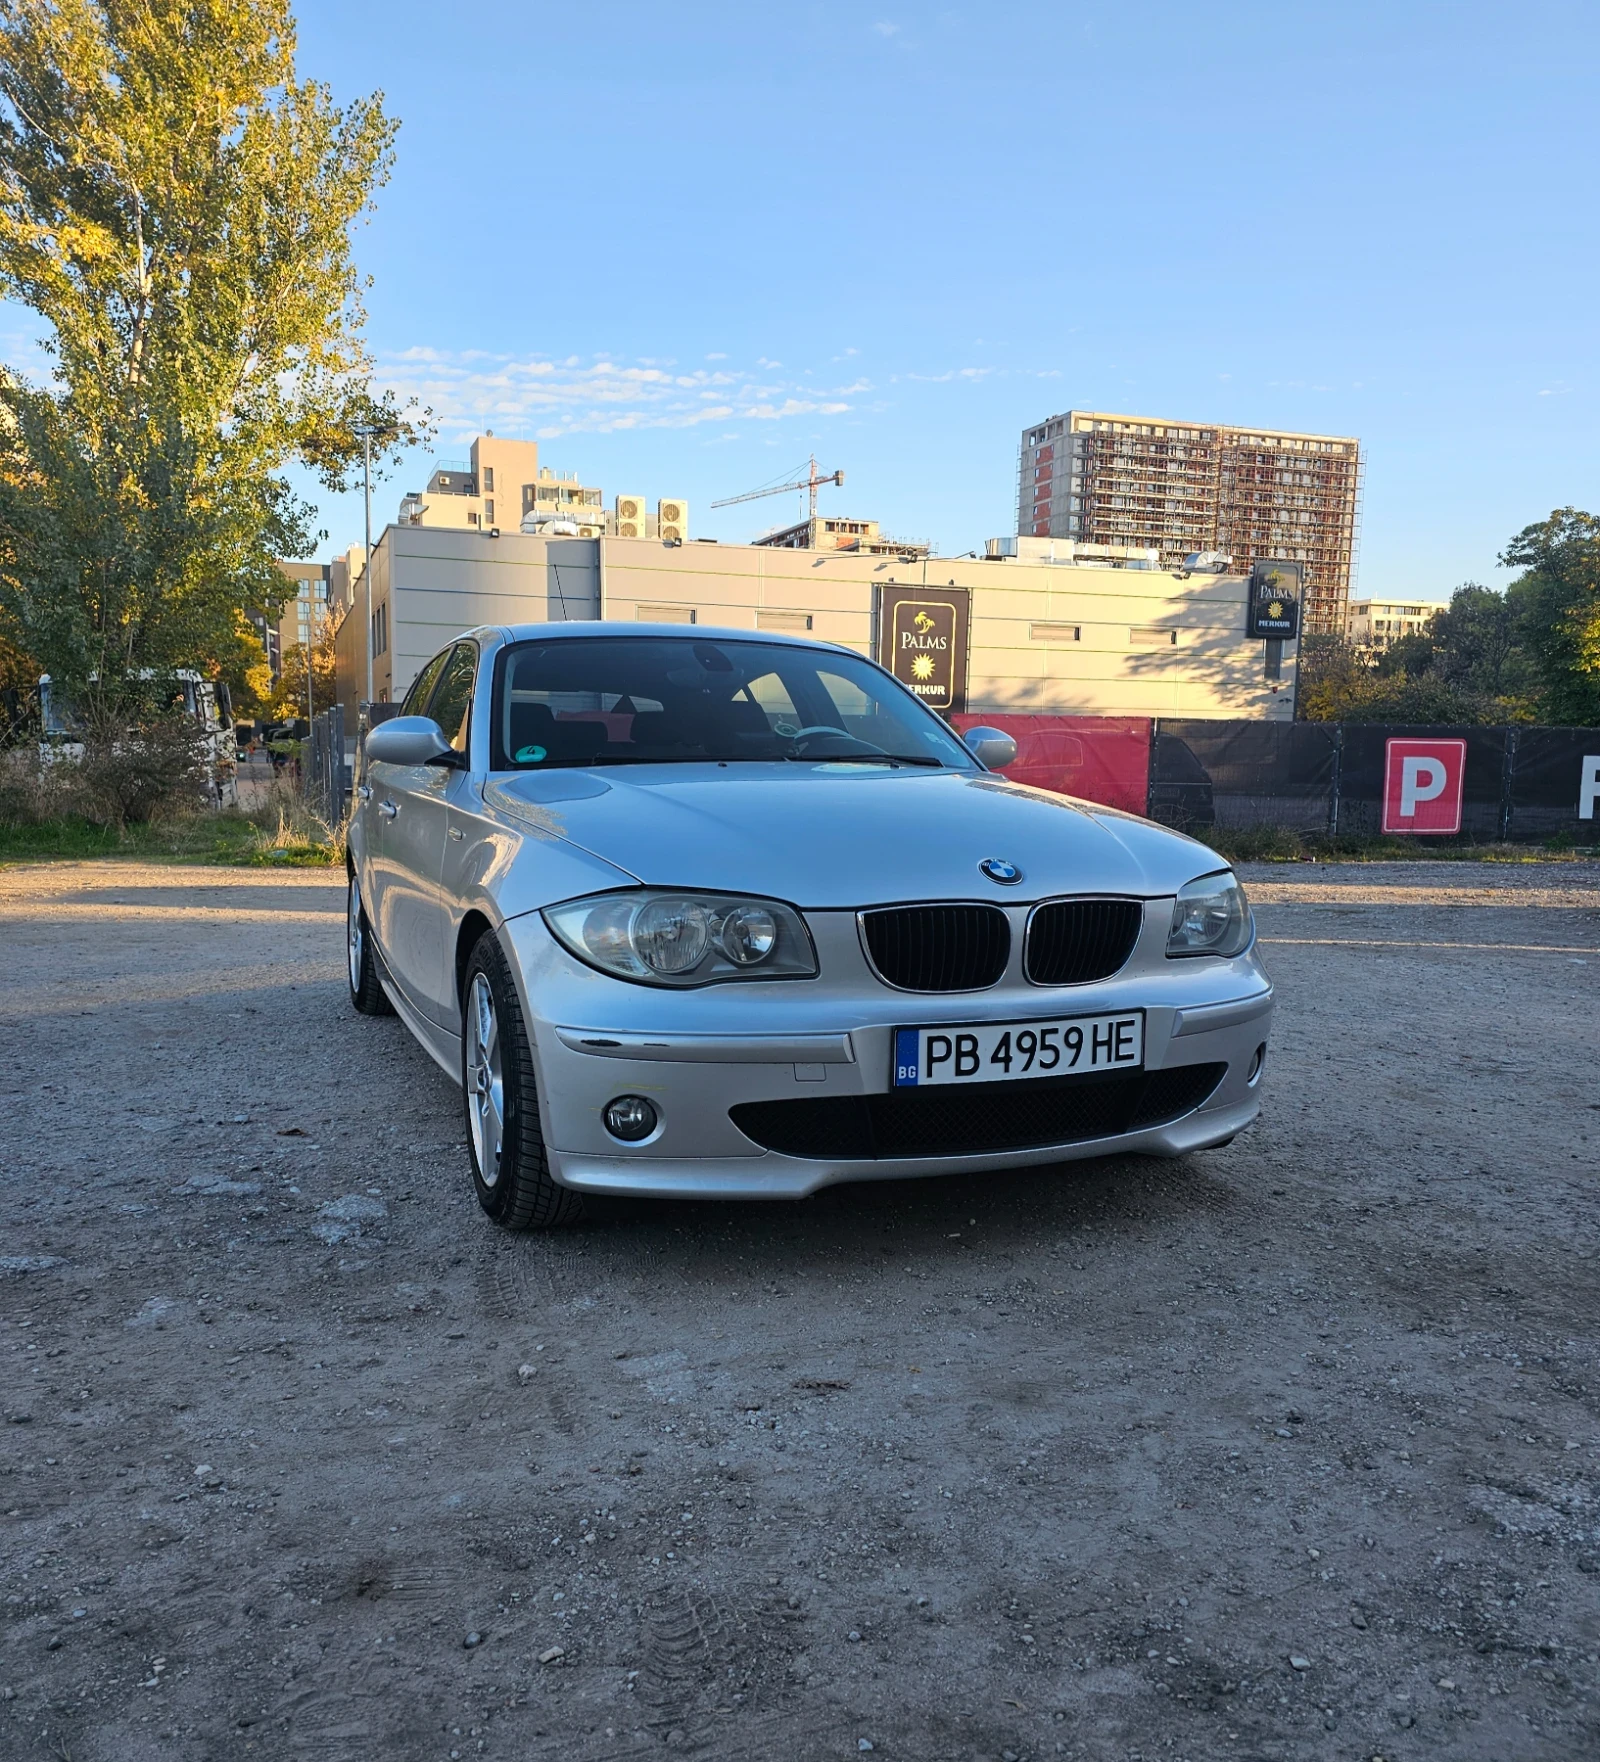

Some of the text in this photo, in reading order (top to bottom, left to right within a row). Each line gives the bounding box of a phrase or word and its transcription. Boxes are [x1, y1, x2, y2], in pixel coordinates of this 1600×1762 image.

[1260, 585, 1293, 600] PALMS
[1258, 619, 1291, 628] MERKUR
[901, 631, 947, 650] PALMS
[906, 684, 946, 696] ERKUR
[1400, 756, 1447, 817] P
[926, 1019, 1136, 1079] PB 4959 HE
[898, 1065, 917, 1080] BG
